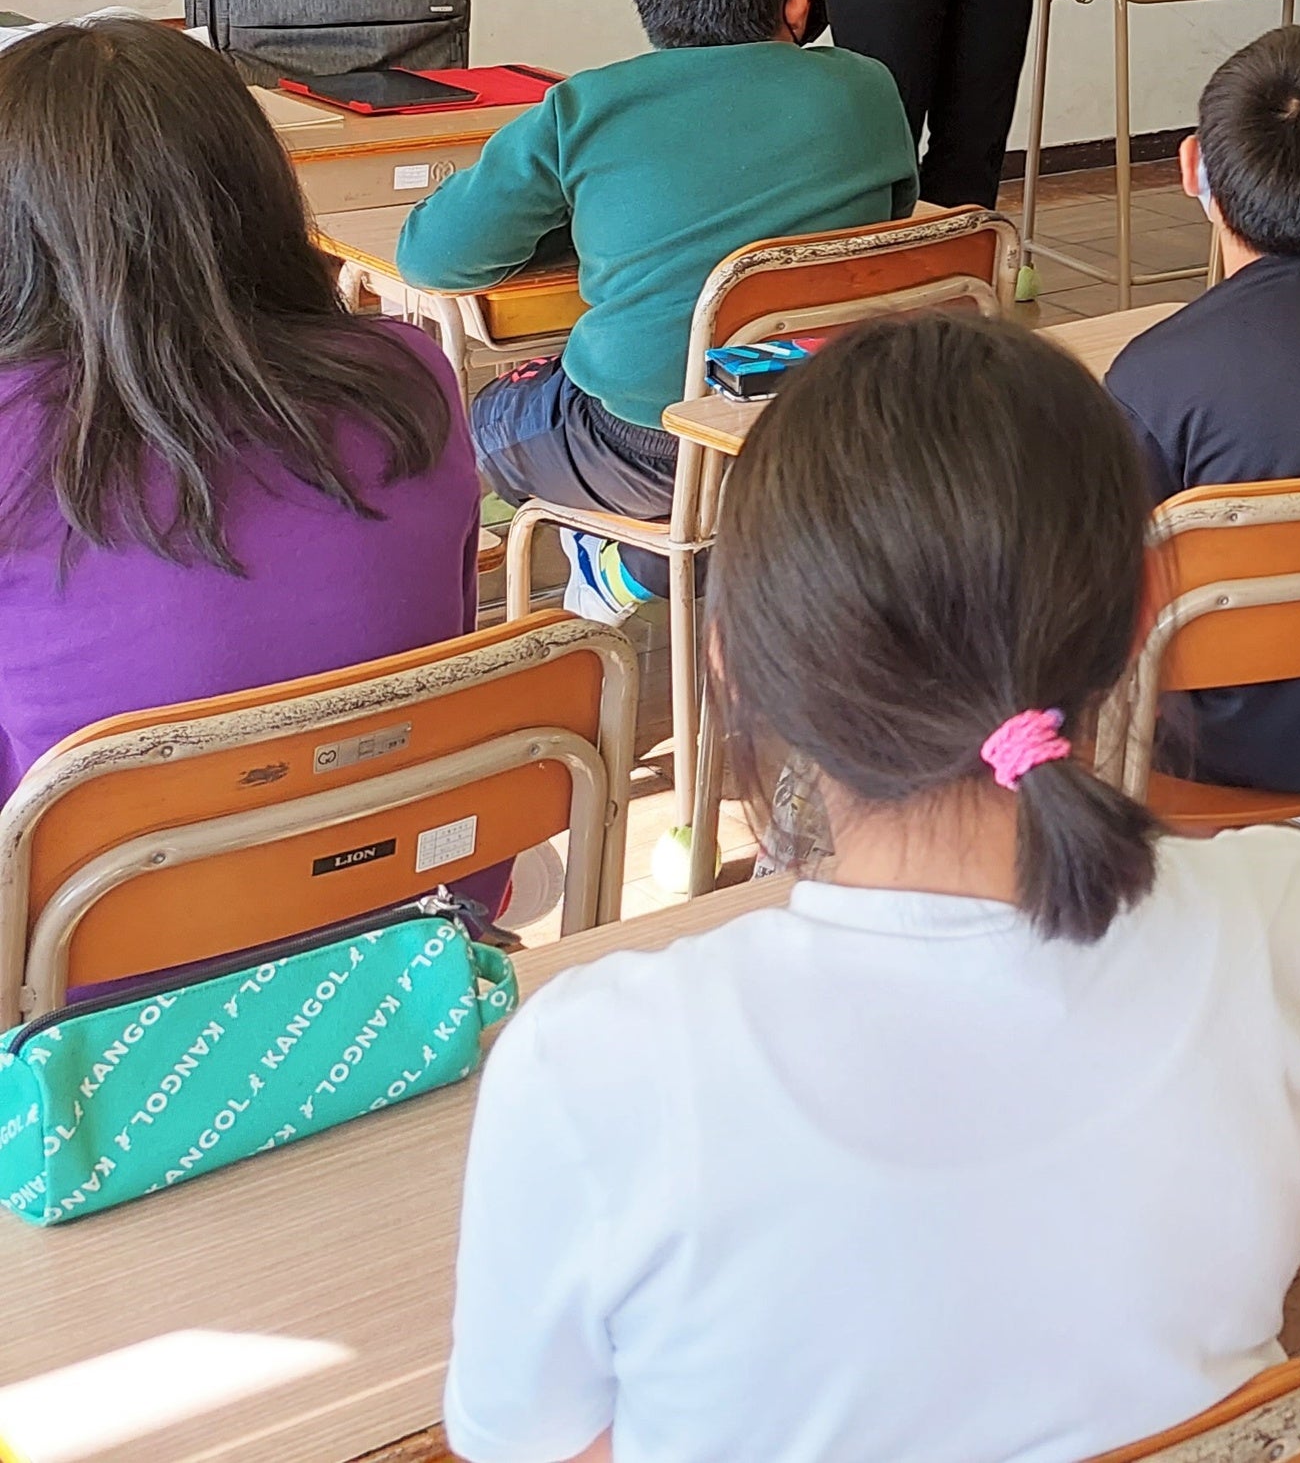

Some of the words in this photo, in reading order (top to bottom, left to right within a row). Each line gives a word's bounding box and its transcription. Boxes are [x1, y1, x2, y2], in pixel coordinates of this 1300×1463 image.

[334, 847, 377, 868] LION
[80, 995, 177, 1098] KANGOL
[261, 970, 348, 1069] KANGOL
[316, 995, 400, 1093] KANGOL
[131, 1021, 225, 1125] KANGOL
